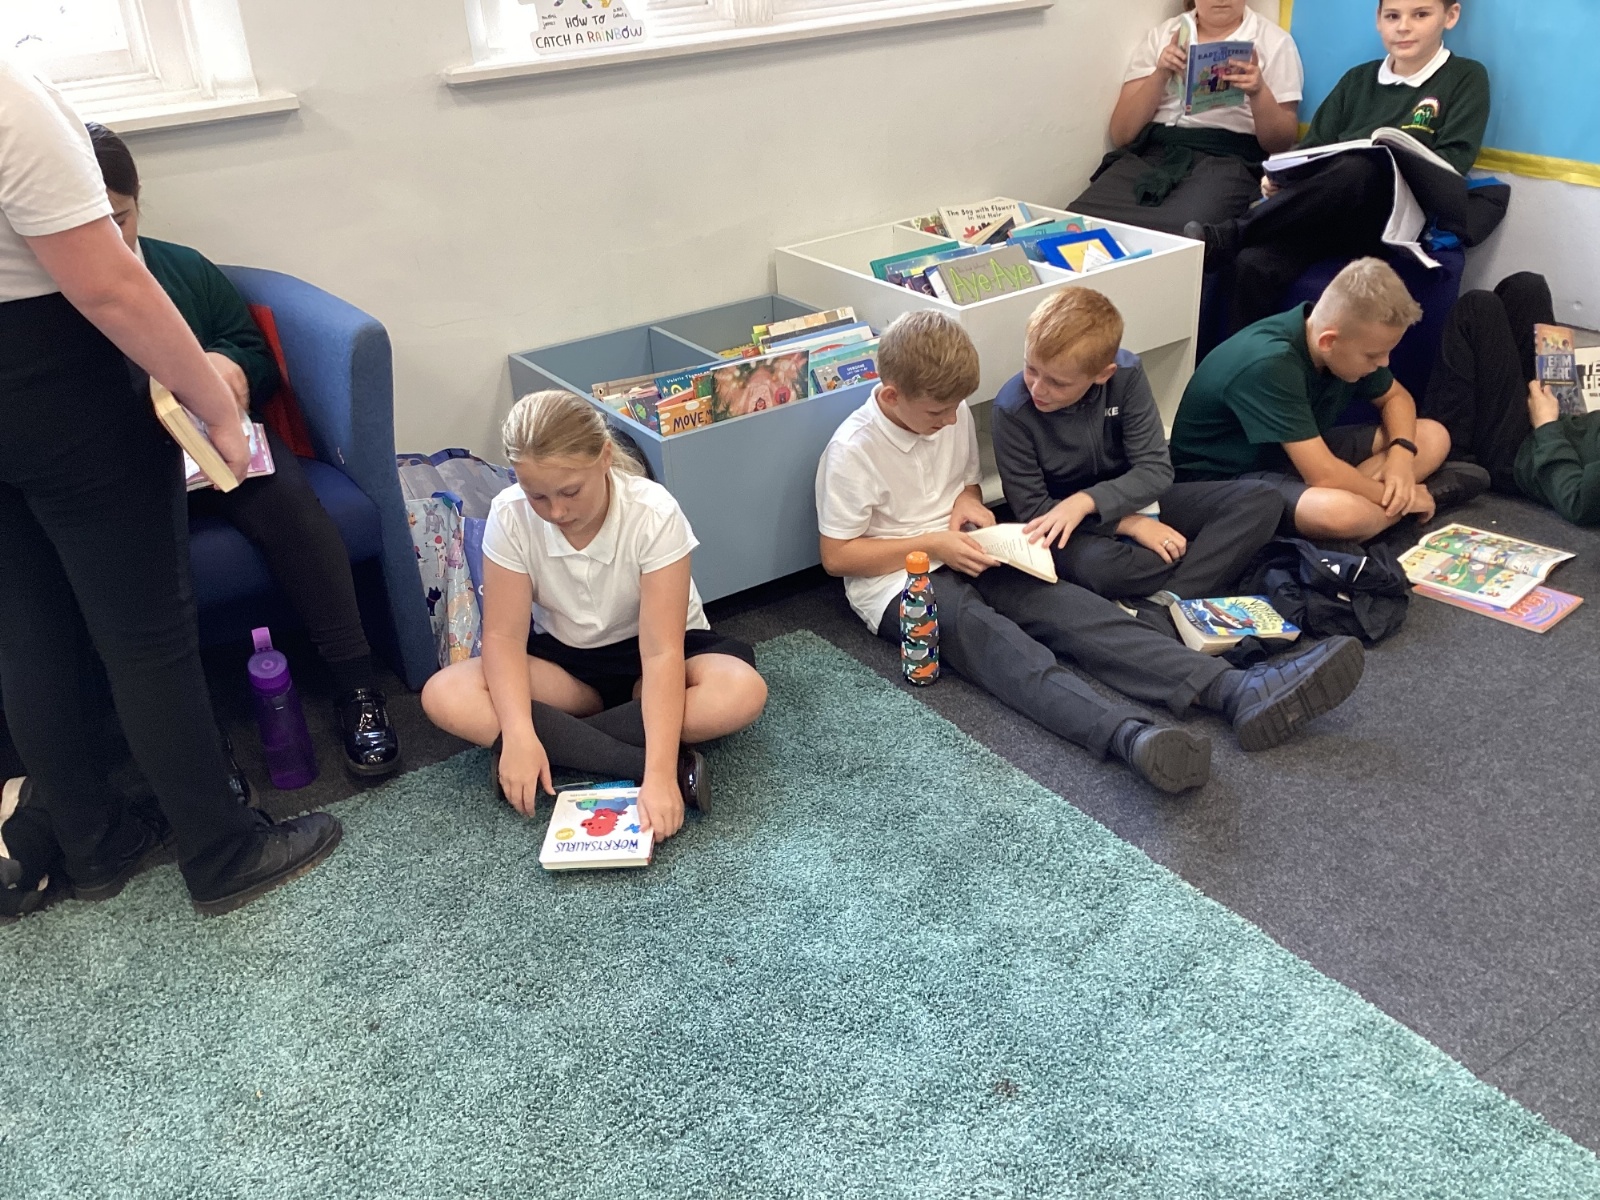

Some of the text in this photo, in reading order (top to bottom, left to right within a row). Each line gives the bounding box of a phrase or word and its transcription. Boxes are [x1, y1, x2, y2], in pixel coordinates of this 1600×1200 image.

[565, 14, 588, 29] HOW
[592, 14, 605, 25] TO
[535, 33, 571, 49] CATCH
[576, 33, 584, 44] A
[961, 208, 974, 217] Boy
[975, 206, 990, 215] with
[991, 203, 1016, 212] Flowers
[1585, 361, 1600, 376] TE
[1582, 375, 1600, 390] HE
[1105, 406, 1119, 417] KE
[554, 838, 639, 853] WORRYSAURUS
